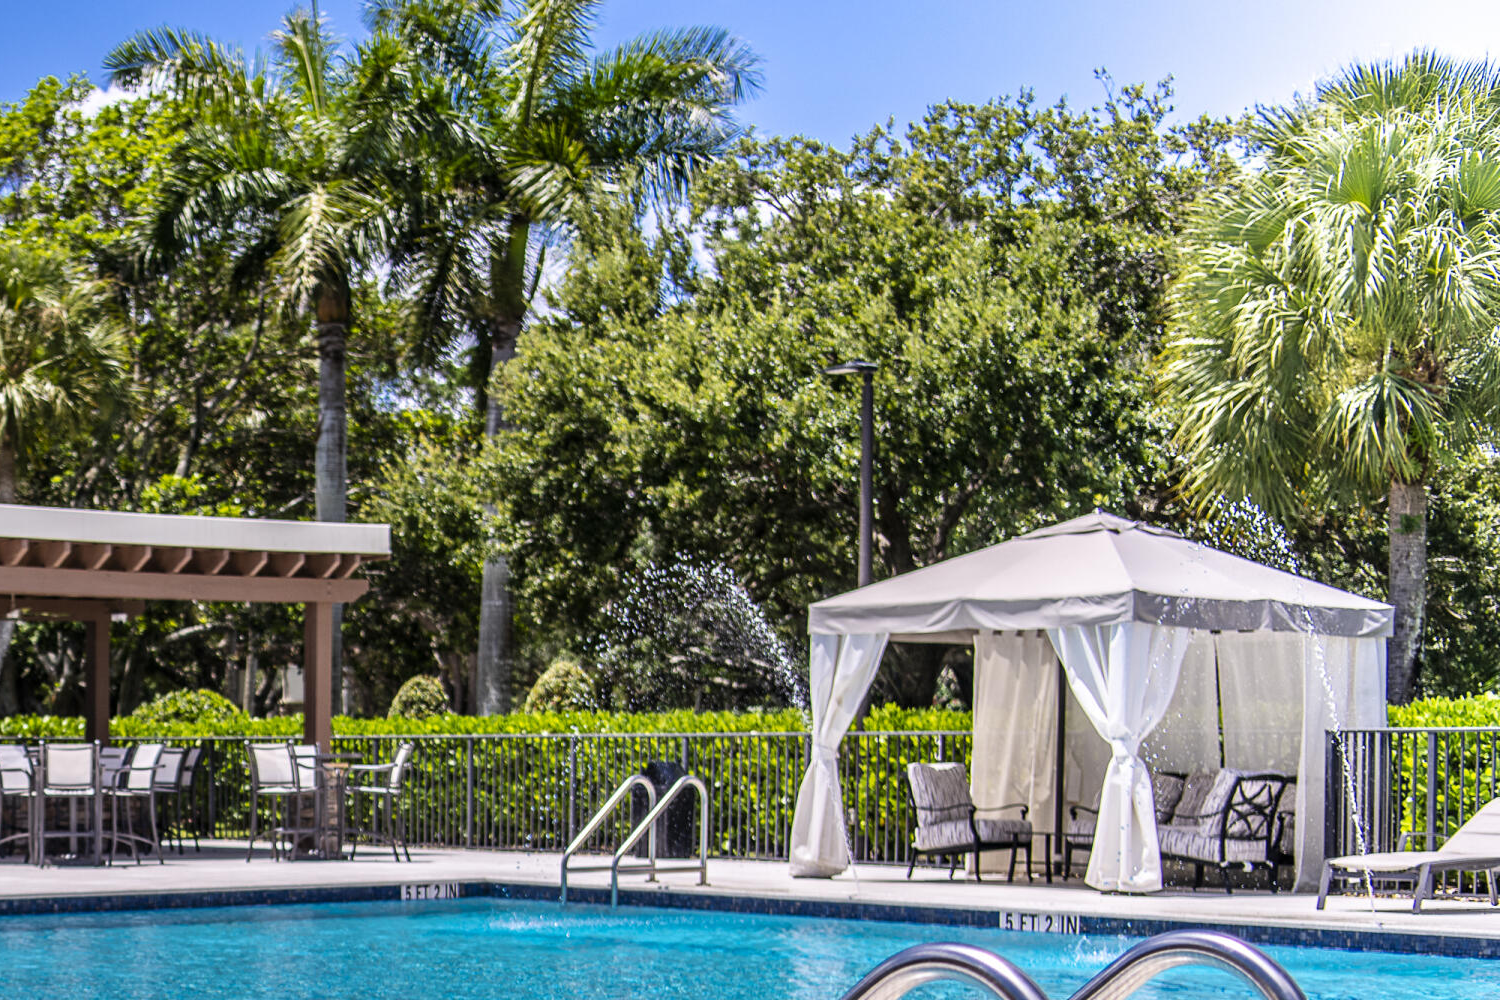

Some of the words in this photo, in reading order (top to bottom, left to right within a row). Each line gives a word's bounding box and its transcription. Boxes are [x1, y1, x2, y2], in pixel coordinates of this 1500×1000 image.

[406, 884, 412, 900] 5
[417, 884, 430, 900] FT
[445, 883, 457, 898] IN
[1005, 913, 1013, 931] 5
[1020, 913, 1038, 932] FT
[1061, 915, 1077, 934] IN
